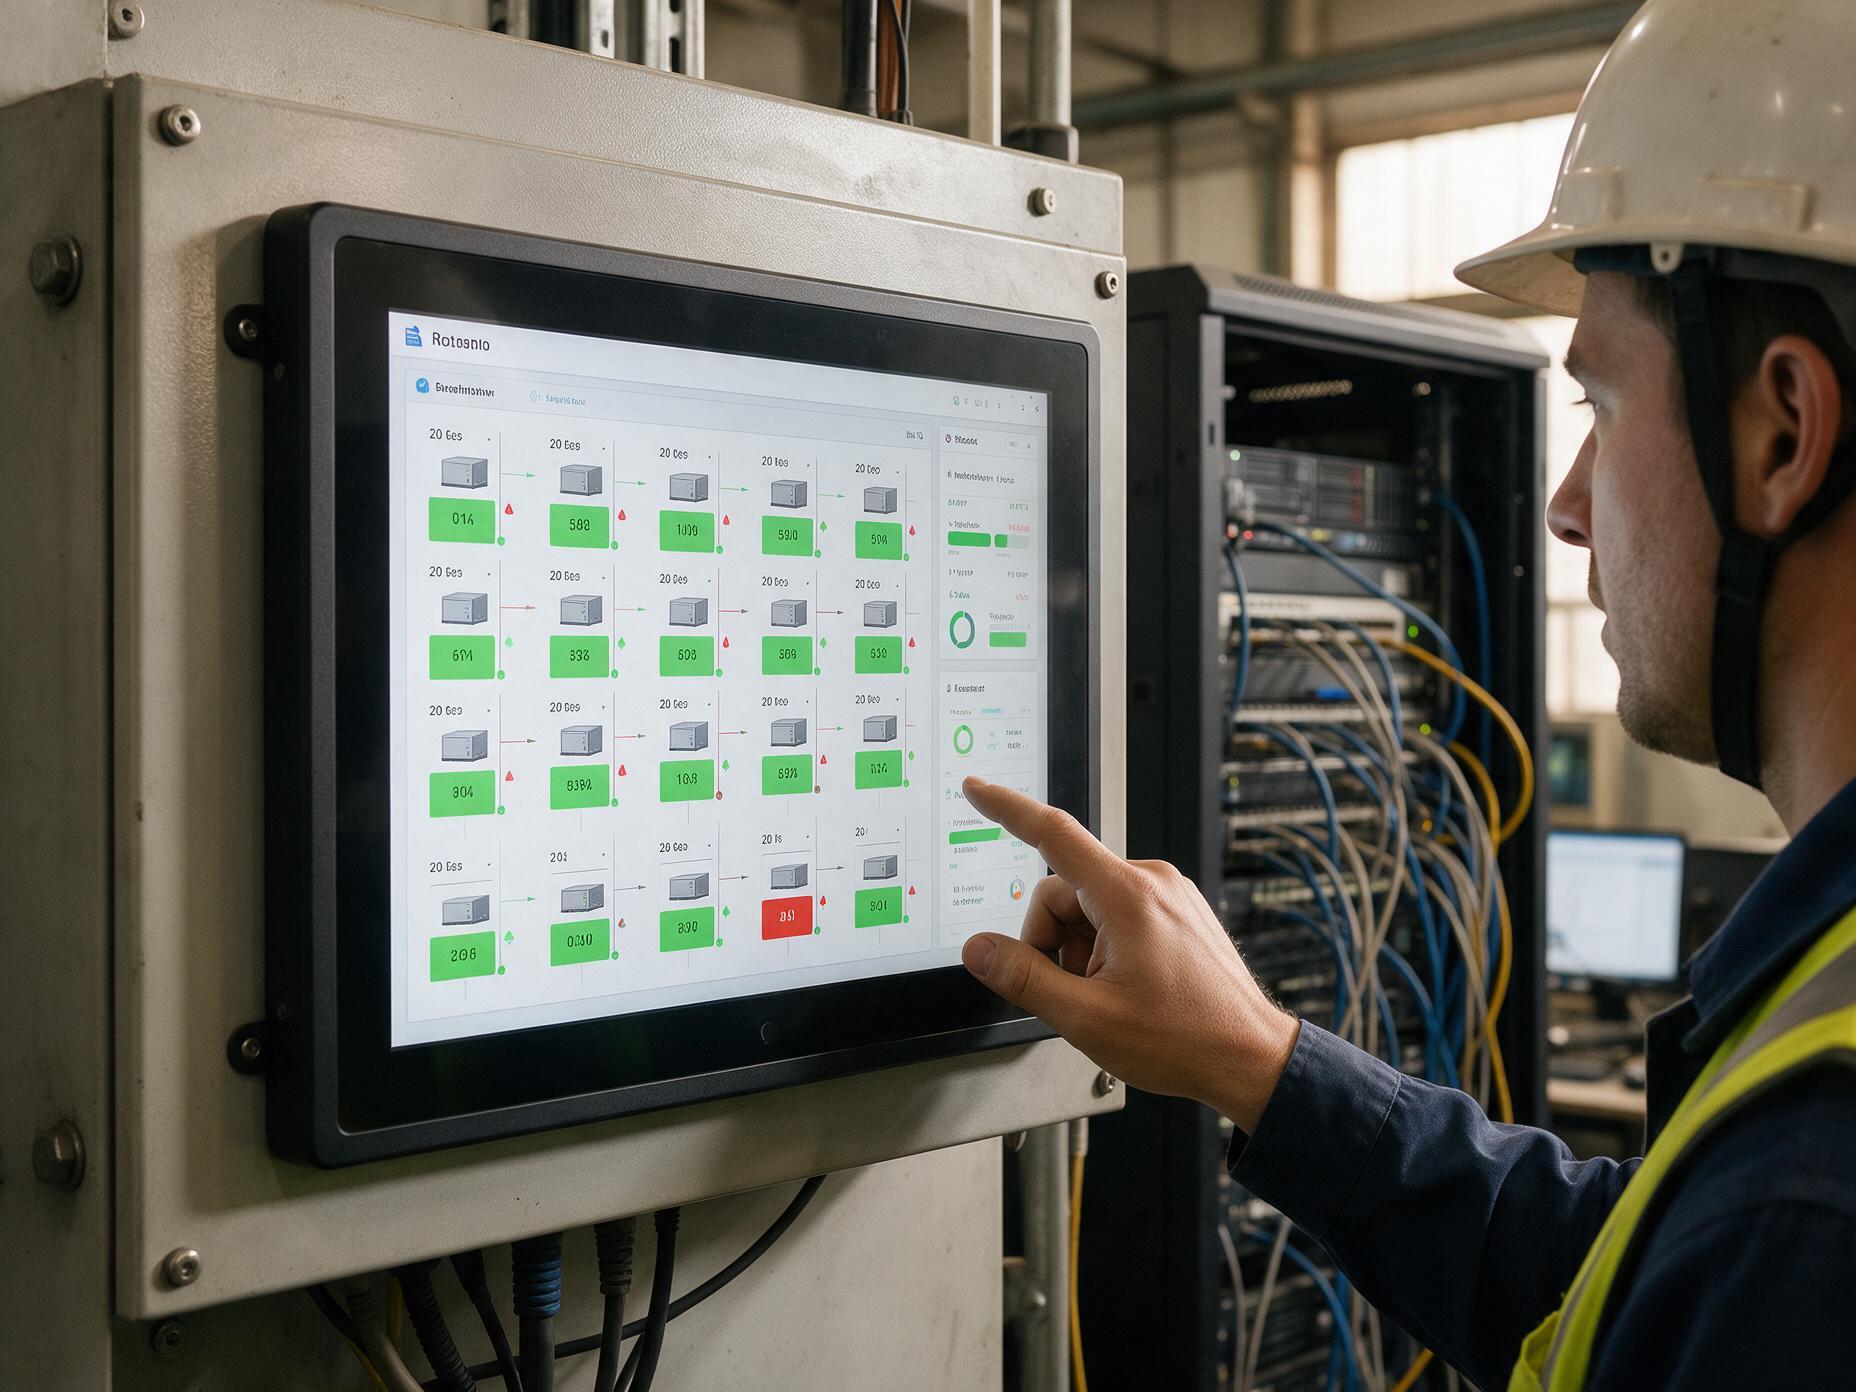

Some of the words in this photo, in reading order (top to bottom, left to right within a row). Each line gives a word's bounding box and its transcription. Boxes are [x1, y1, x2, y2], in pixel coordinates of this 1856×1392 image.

[429, 428, 443, 440] 20
[549, 438, 562, 450] 20
[659, 447, 671, 458] 20
[761, 455, 773, 466] 20
[855, 463, 866, 474] 20
[429, 565, 443, 578] 20
[549, 570, 562, 581] 20
[659, 573, 671, 584] 20
[761, 576, 773, 587] 20
[855, 578, 866, 589] 20
[659, 698, 671, 709] 20
[761, 696, 773, 707] 20
[855, 694, 866, 705] 20
[429, 704, 443, 717] 20
[549, 701, 563, 713] 20
[429, 861, 443, 873] 20
